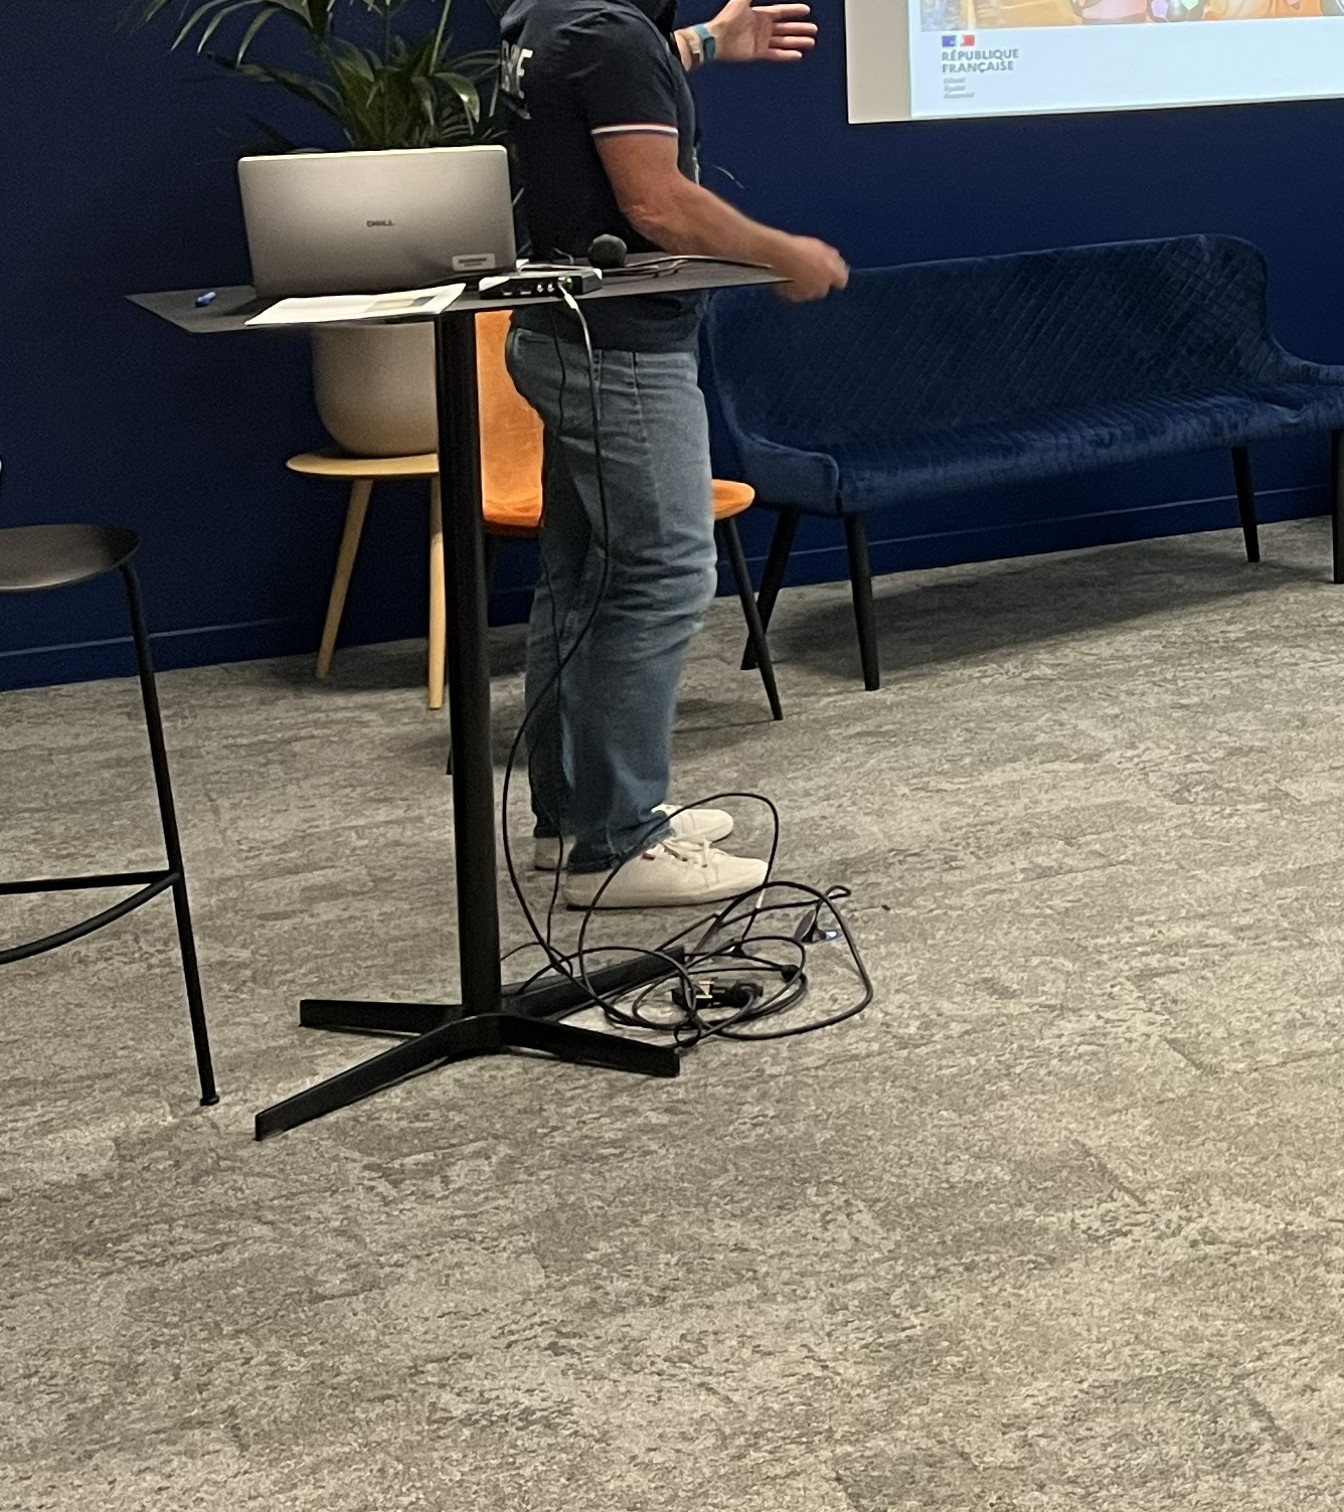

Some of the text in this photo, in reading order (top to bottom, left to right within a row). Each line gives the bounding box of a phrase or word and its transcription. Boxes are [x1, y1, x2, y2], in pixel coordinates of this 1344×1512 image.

[942, 48, 1019, 62] RÉPUBLIQUE
[942, 60, 1014, 73] FRANÇAISE
[366, 220, 395, 228] DELL
